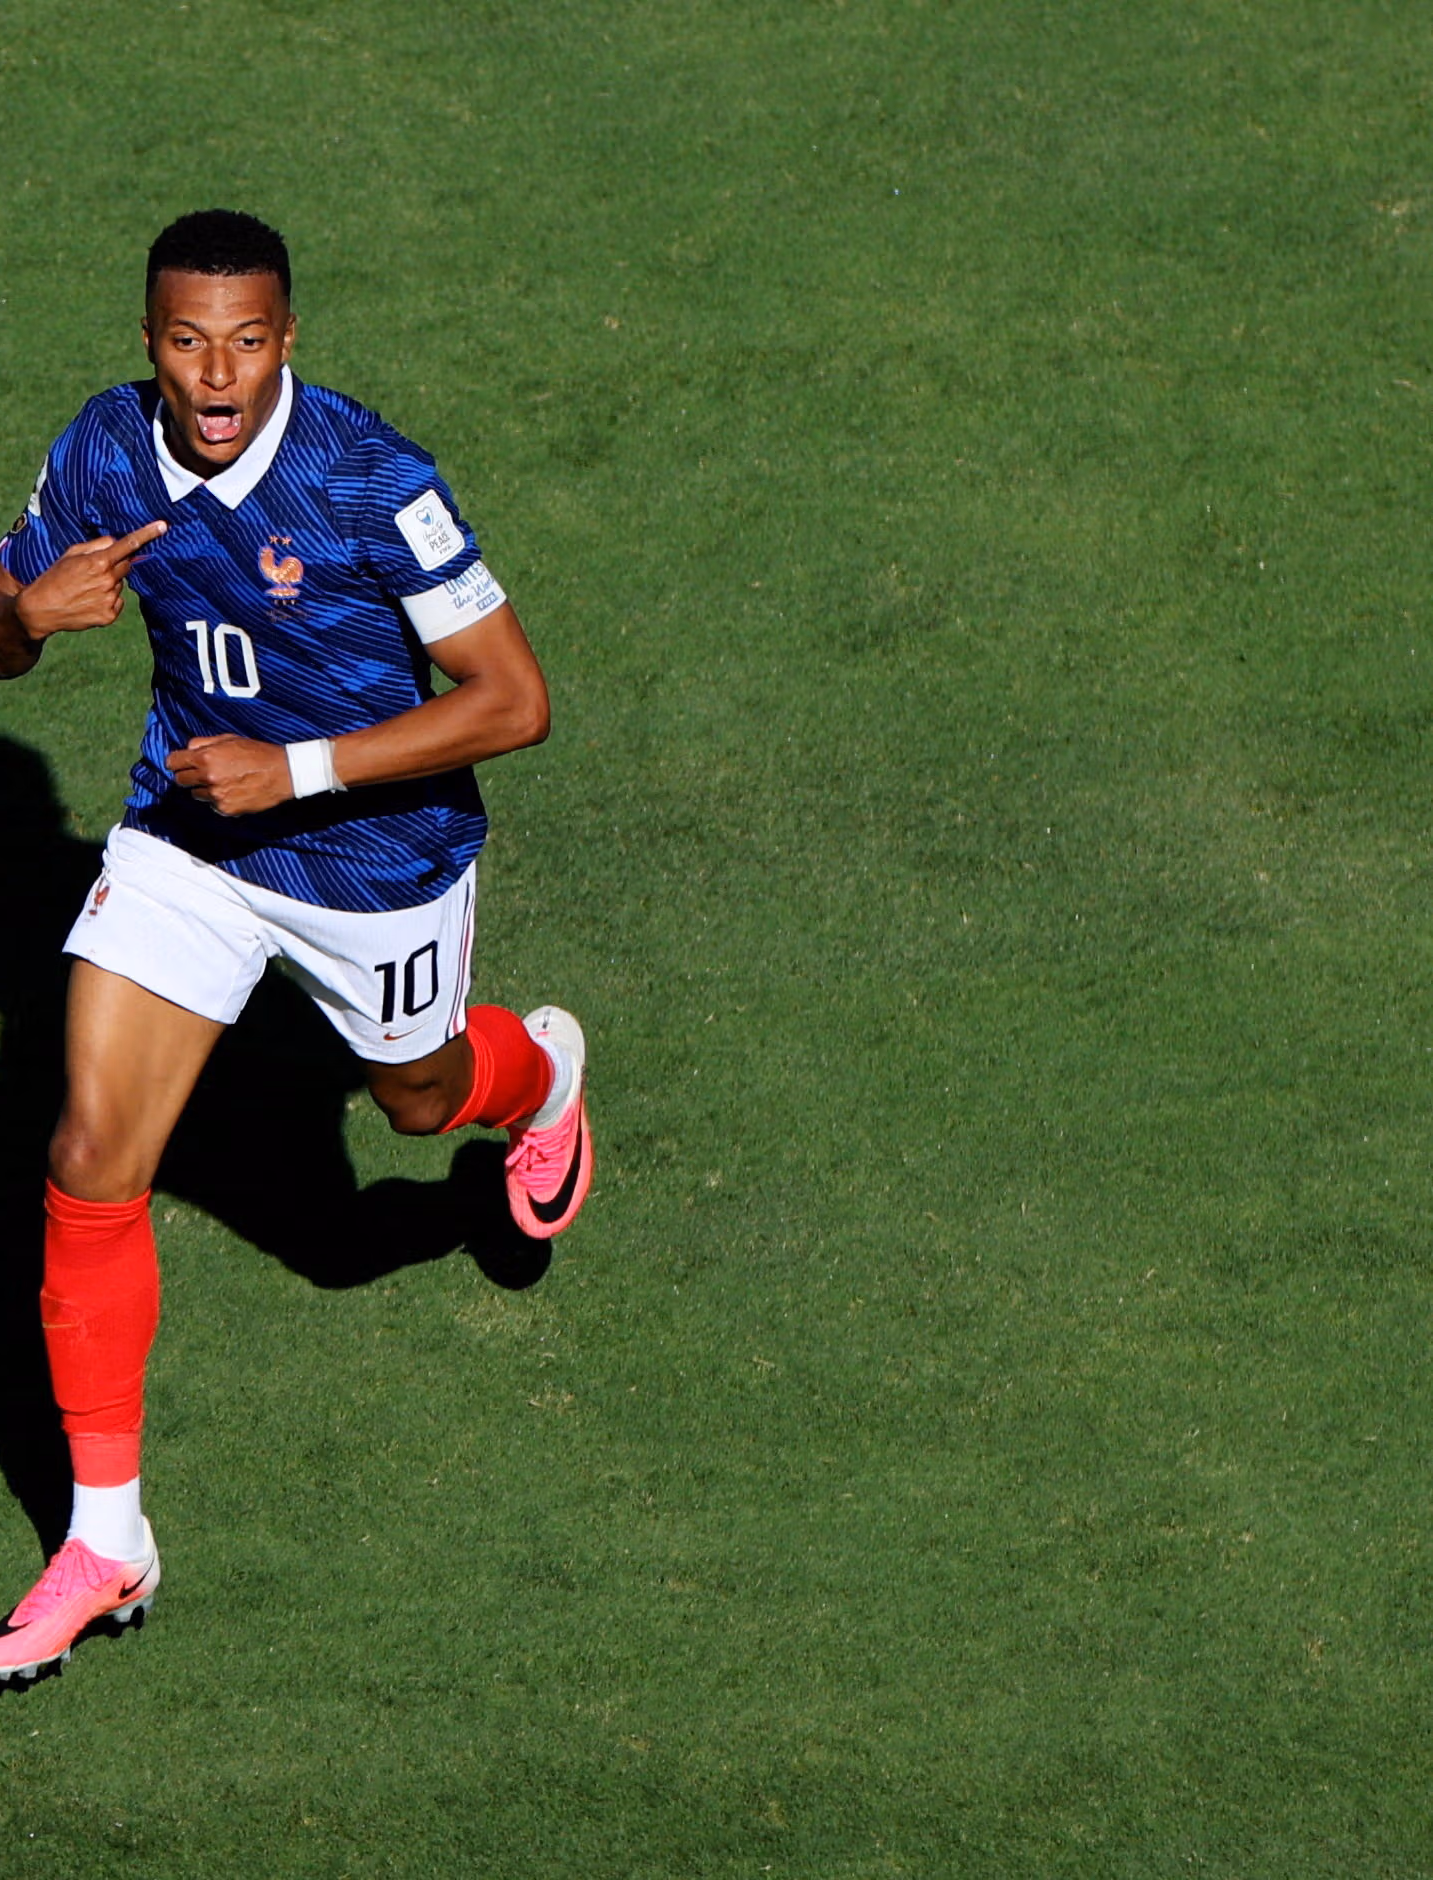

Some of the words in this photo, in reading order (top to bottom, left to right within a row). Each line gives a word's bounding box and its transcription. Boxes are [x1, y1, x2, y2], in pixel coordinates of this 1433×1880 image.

[452, 594, 474, 609] the
[185, 620, 261, 698] 10
[374, 939, 439, 1025] 10
